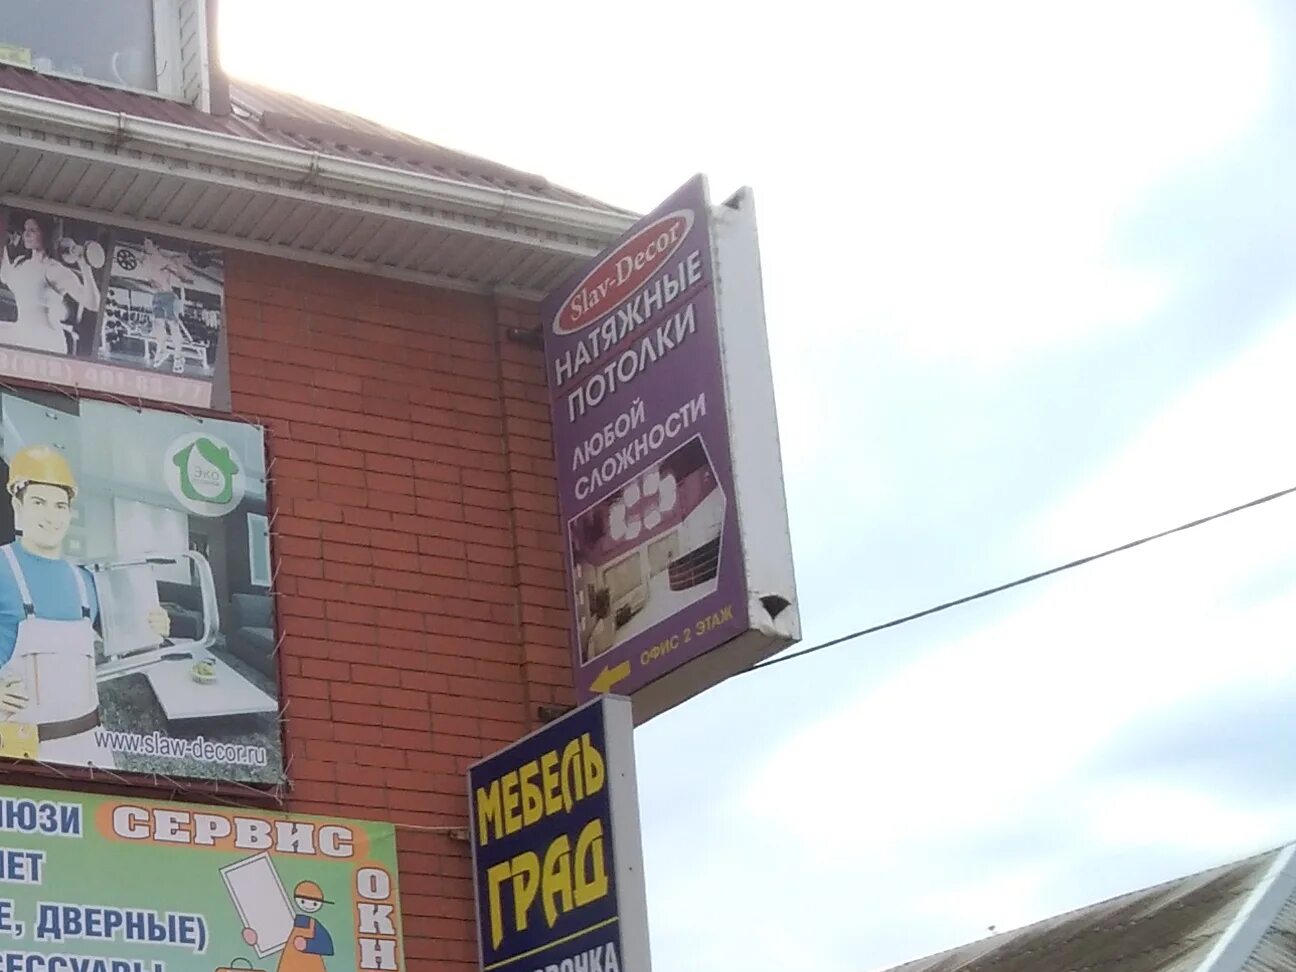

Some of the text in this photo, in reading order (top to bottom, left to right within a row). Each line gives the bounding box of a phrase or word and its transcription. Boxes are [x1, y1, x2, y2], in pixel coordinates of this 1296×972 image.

[554, 249, 703, 387] НАТЯЖНЫЕ
[567, 302, 697, 423] ПОТОЛКИ
[572, 398, 646, 472] ЛЮБОЙ
[574, 392, 707, 501] СЛОЖНОСТИ
[640, 604, 734, 664] ОФИС 2 ЭТАЖ
[95, 728, 266, 765] www.slaw-decor.ru
[477, 732, 605, 847] МЕБЕЛЬ
[112, 804, 355, 858] СЕРВИС
[37, 902, 208, 951] ДВЕРНЫЕ)
[487, 818, 608, 952] ГРАД
